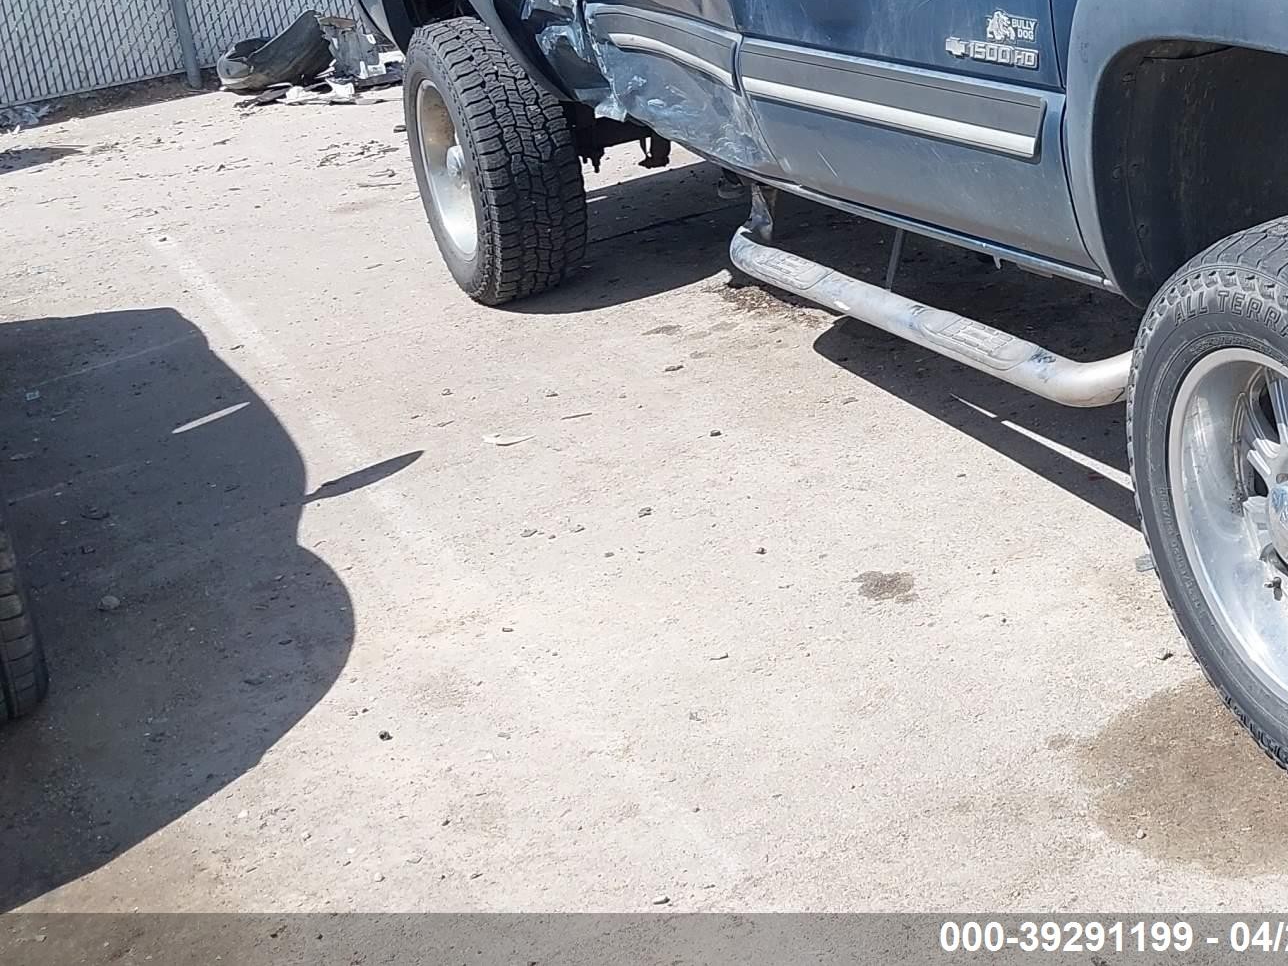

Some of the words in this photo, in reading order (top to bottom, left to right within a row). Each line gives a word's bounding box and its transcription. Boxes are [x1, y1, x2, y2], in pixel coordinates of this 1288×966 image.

[1011, 19, 1036, 29] BULLY
[1017, 29, 1034, 40] DOG
[1173, 290, 1209, 327] ALL
